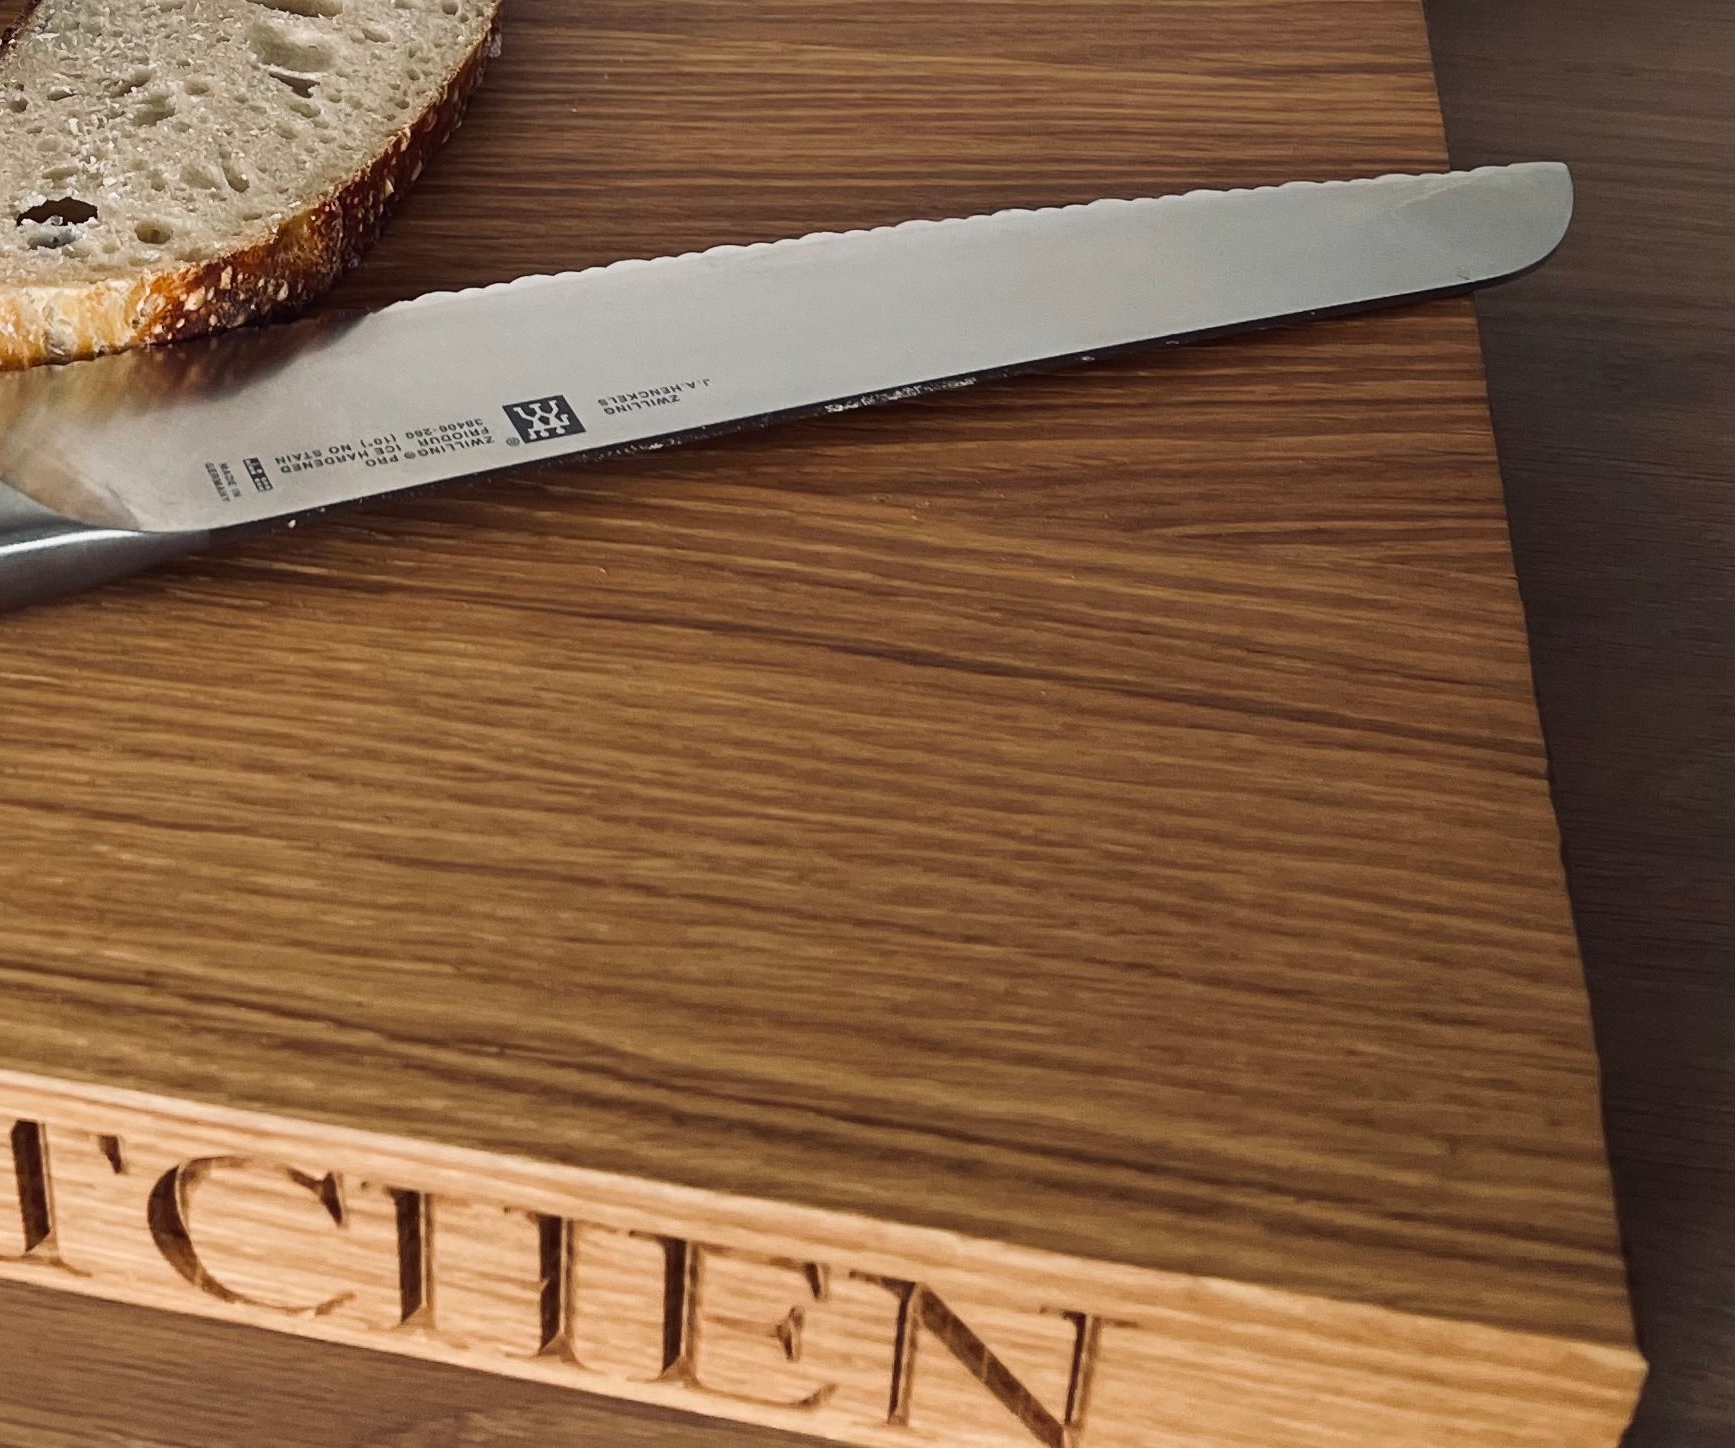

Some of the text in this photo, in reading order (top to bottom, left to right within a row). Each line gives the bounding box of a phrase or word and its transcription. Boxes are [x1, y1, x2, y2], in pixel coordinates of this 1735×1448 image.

[603, 394, 681, 415] ZWILLING
[274, 449, 323, 466] STAIN
[280, 426, 490, 474] FRIODUR ICE HARDENED
[328, 443, 352, 455] NO
[365, 454, 399, 467] PRO
